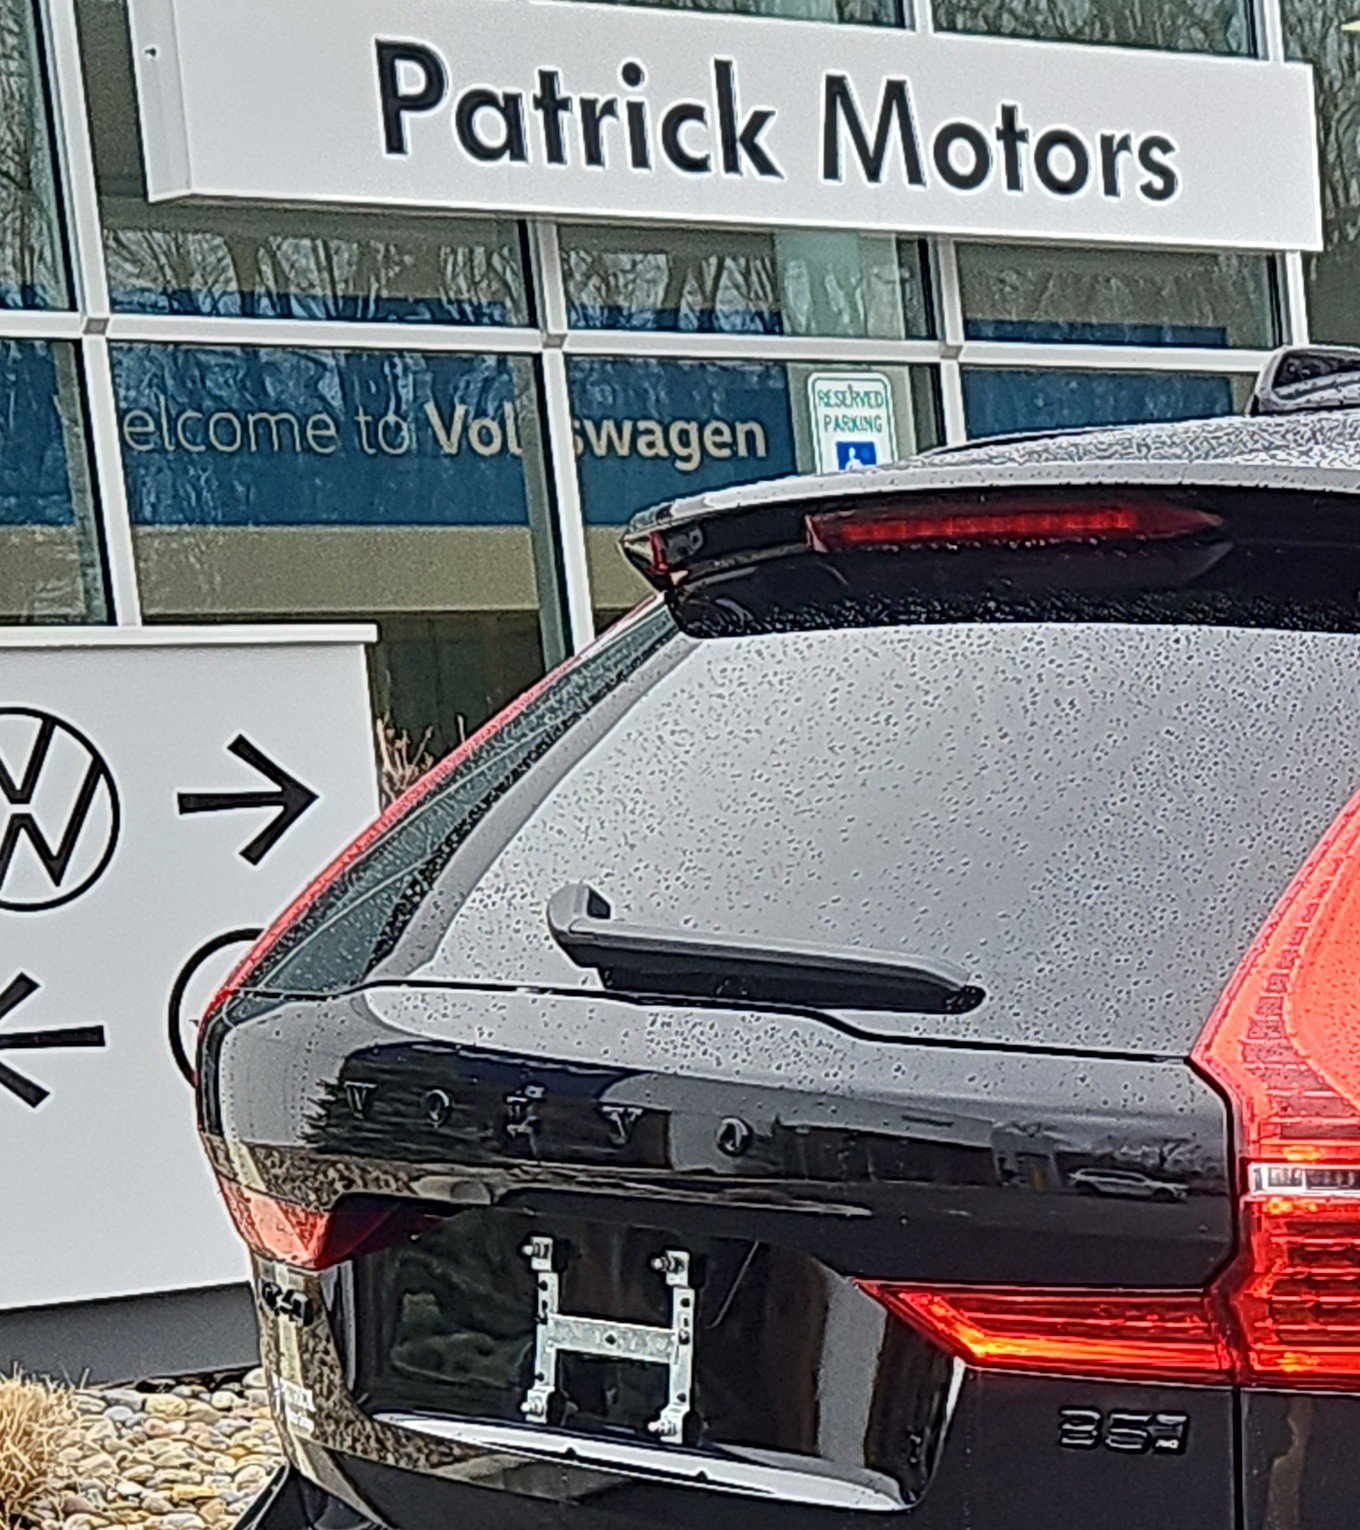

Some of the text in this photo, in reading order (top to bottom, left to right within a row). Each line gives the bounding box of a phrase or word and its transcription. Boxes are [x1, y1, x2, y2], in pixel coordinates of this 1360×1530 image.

[374, 38, 1180, 202] Patrick Motors
[817, 388, 884, 408] RESERVED
[122, 395, 768, 472] elcome to Volswagen
[823, 414, 883, 433] PARKING
